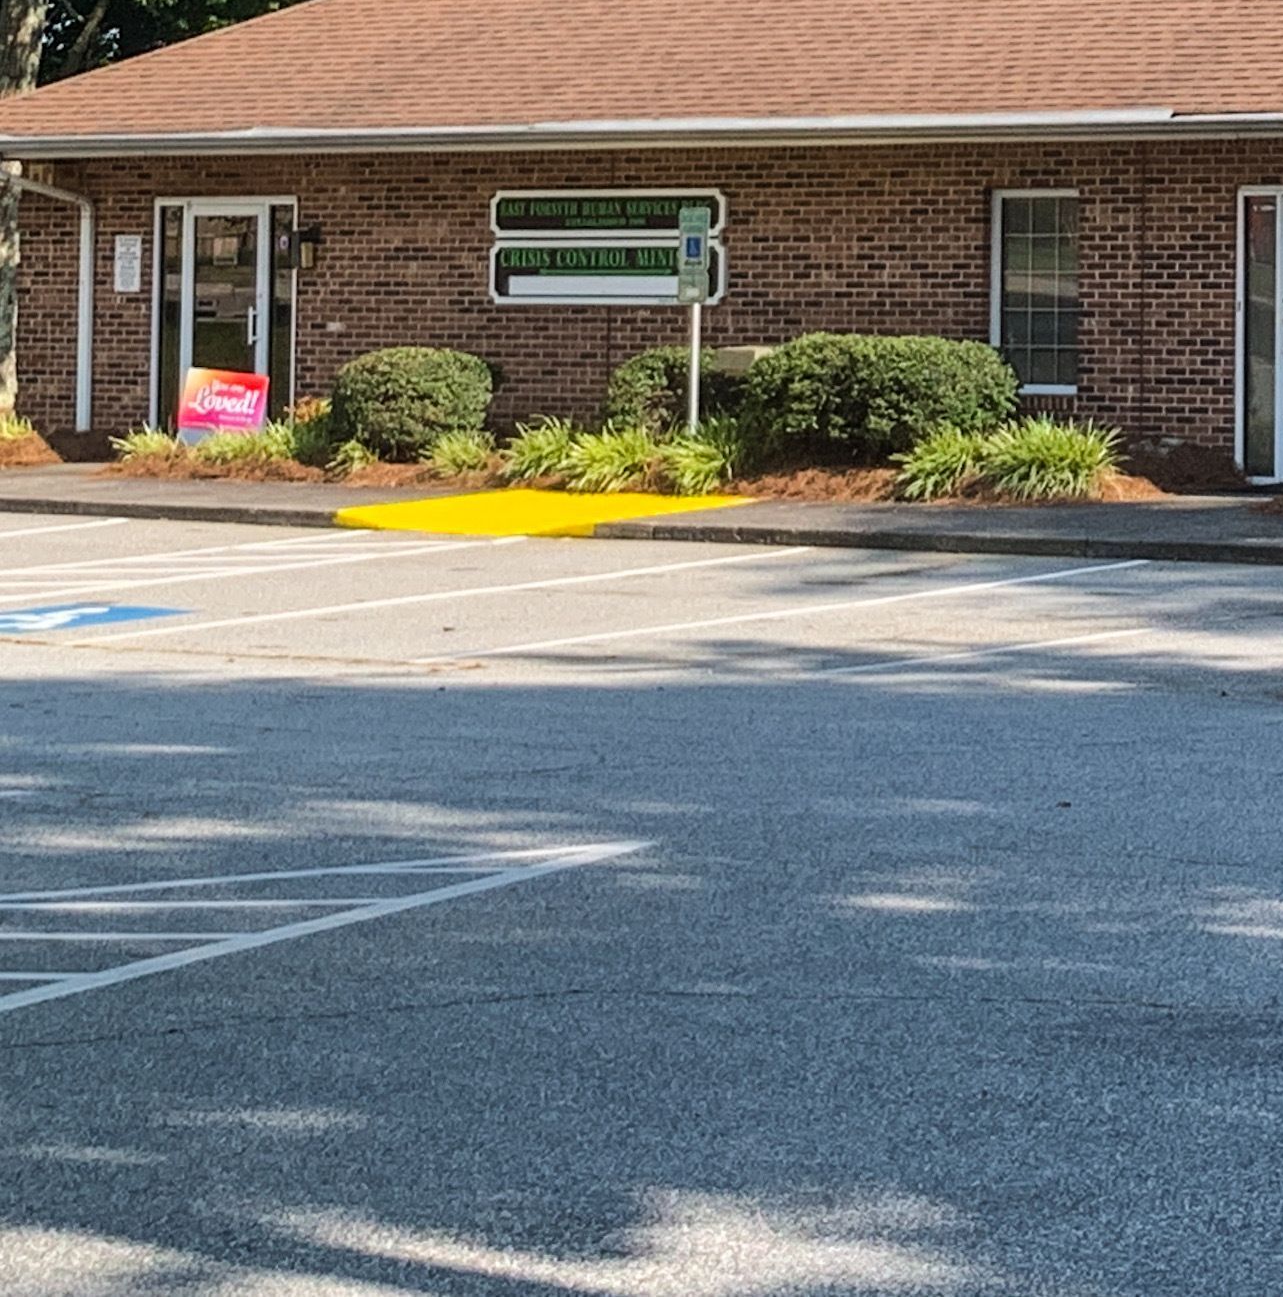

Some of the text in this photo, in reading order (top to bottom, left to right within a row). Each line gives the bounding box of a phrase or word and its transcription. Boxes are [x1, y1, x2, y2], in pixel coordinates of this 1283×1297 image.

[625, 201, 678, 216] SERVICES
[501, 249, 676, 268] CRISIS CONTROL MINI
[188, 385, 259, 415] Loved!
